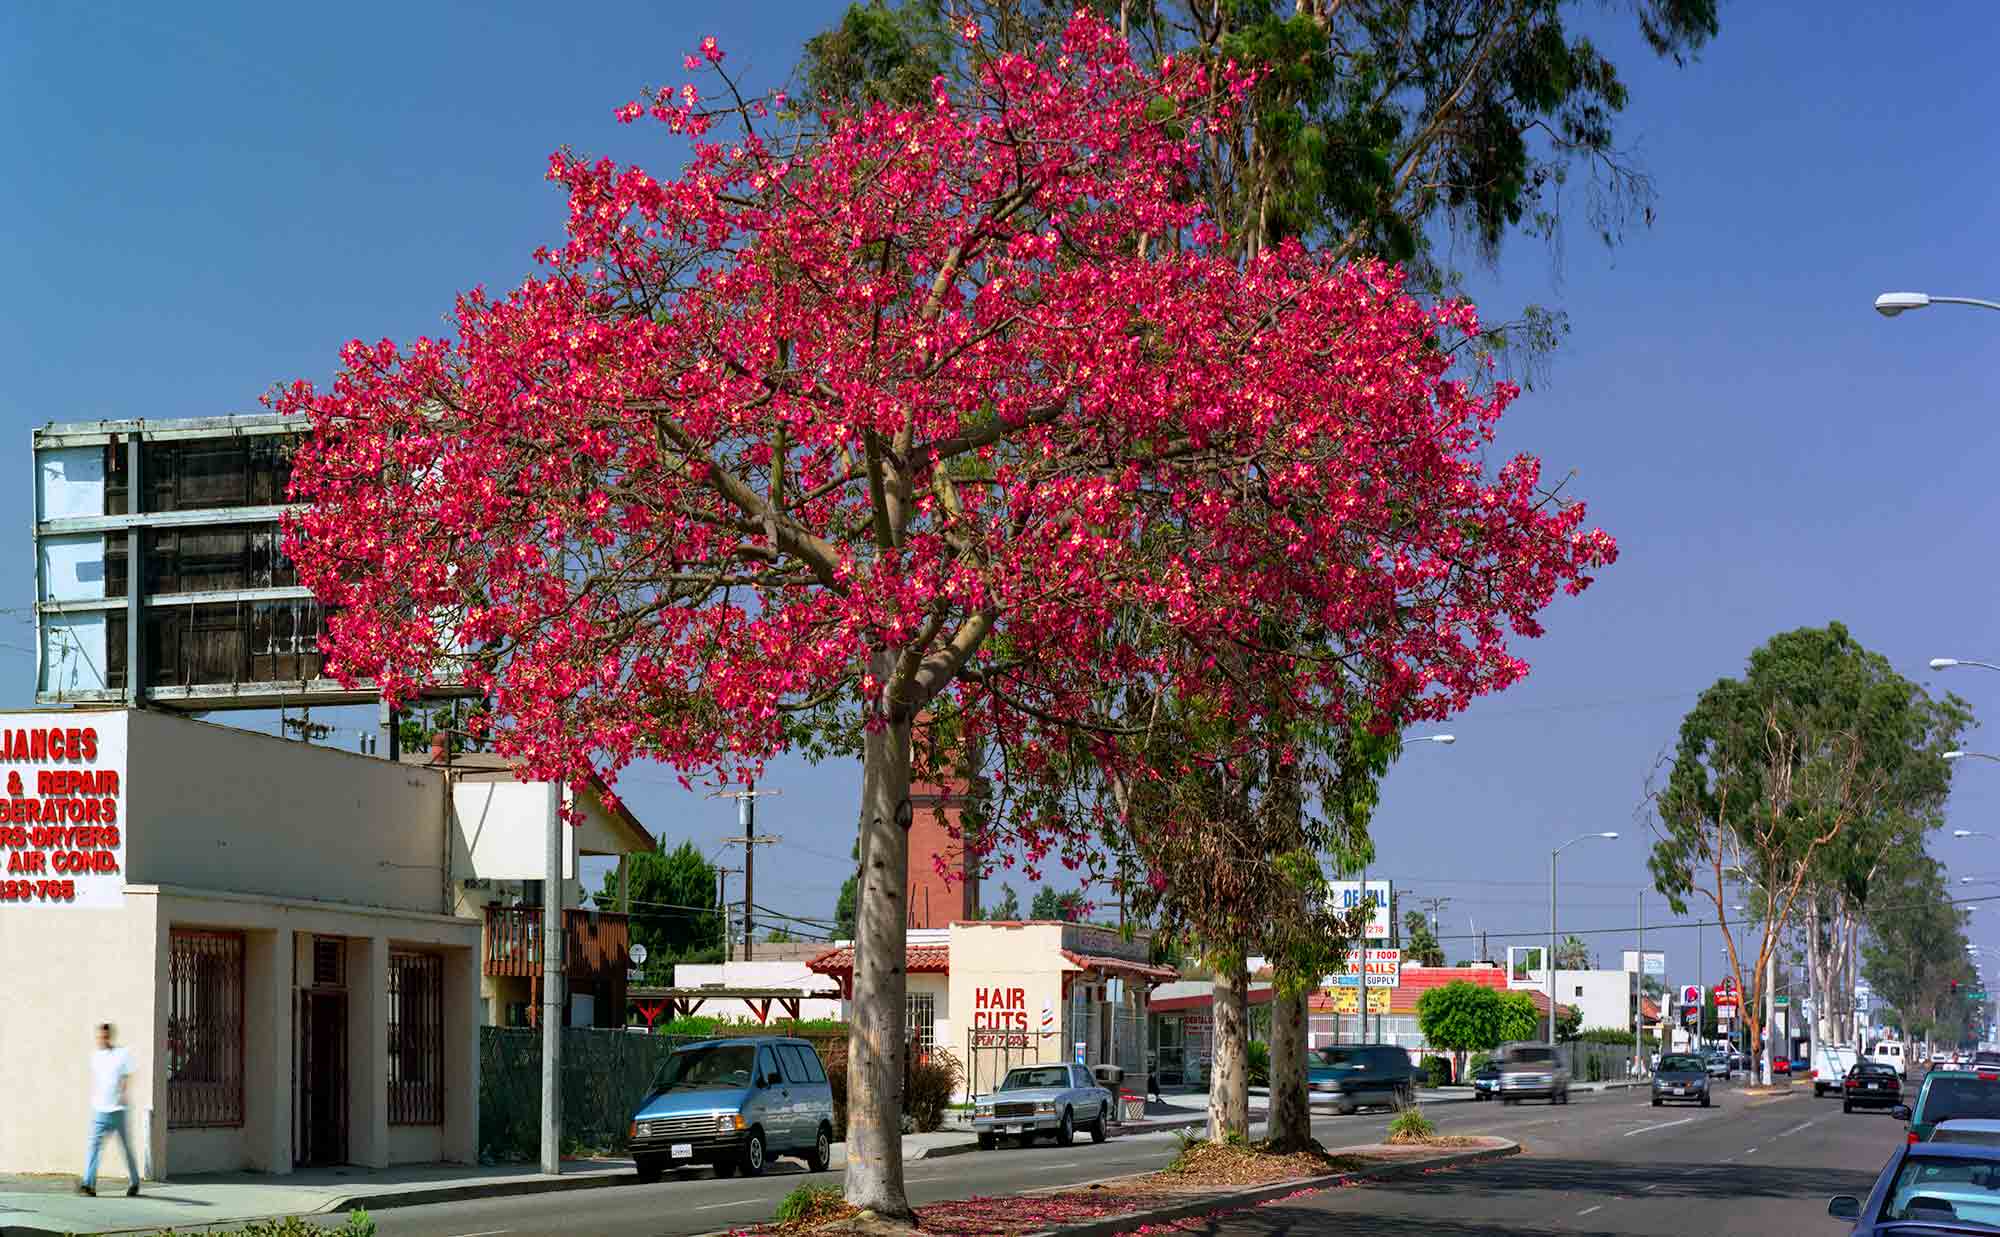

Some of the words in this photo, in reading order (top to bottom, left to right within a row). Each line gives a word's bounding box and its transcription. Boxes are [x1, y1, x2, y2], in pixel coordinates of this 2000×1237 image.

[0, 728, 98, 763] IANCES
[7, 771, 24, 798] &
[37, 770, 119, 798] REPAIR
[7, 850, 47, 874] AIR
[51, 850, 120, 875] COND.
[1376, 951, 1398, 960] FOOD
[1350, 963, 1396, 974] NAILS
[1367, 976, 1395, 985] SUPPLY
[975, 988, 1025, 1009] HAIR
[975, 1011, 1028, 1033] CUTS
[999, 1035, 1006, 1046] 7
